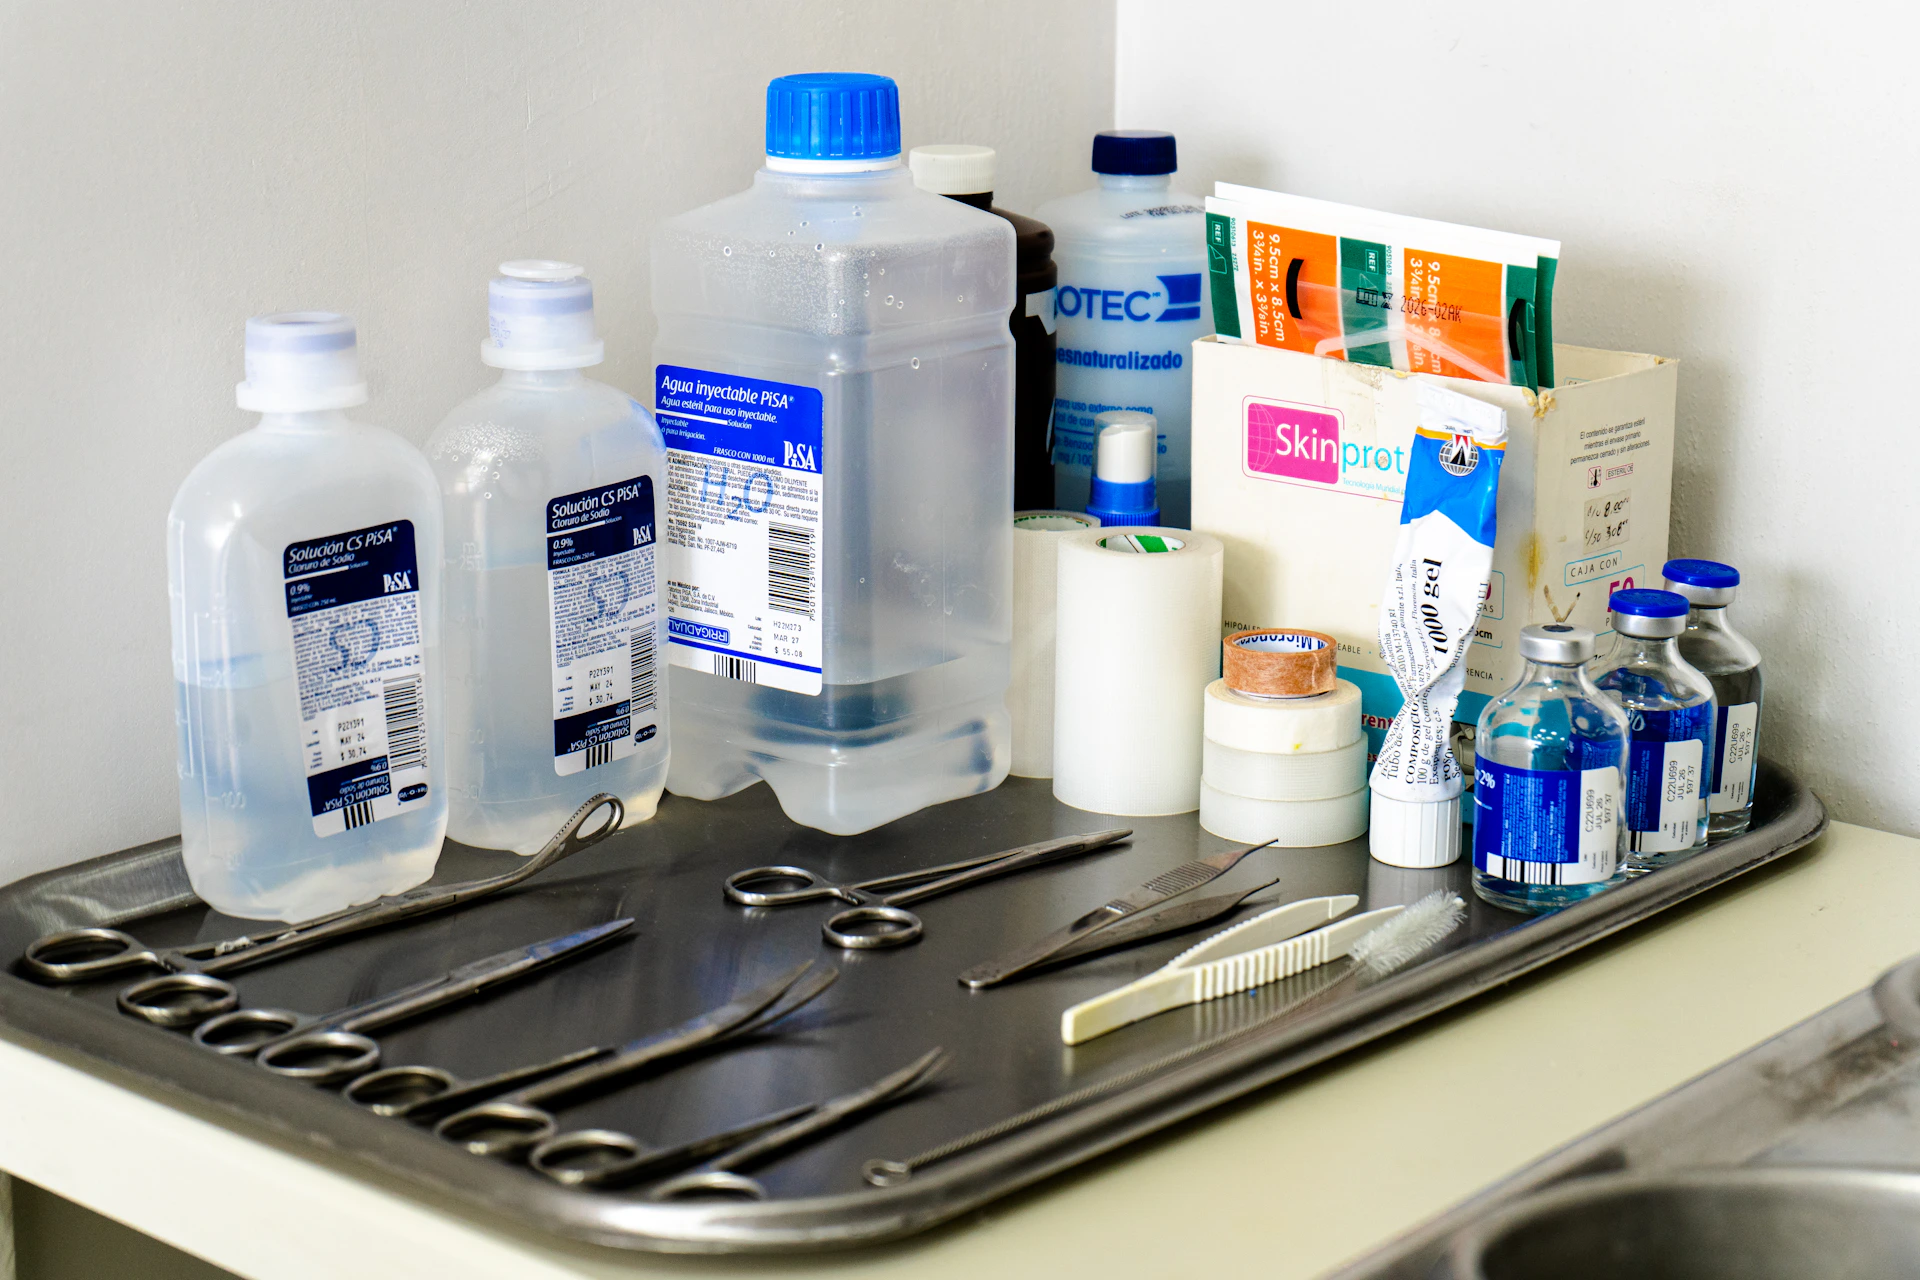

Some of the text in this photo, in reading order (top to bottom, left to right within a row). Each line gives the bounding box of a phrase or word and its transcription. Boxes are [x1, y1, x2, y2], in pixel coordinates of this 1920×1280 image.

[1214, 223, 1222, 243] REF
[1255, 279, 1264, 289] x
[1269, 234, 1285, 342] 9.5cm x 8.5cm
[1057, 285, 1152, 322] OTEC
[661, 376, 693, 395] Agua
[696, 380, 758, 405] inyectable
[661, 396, 778, 424] Agua estéril para uso inyectable.
[1072, 402, 1086, 412] uso
[661, 417, 752, 430] Inyectable Solución
[1586, 427, 1607, 439] contenido
[713, 446, 737, 457] FRASCO
[737, 450, 751, 460] CON
[752, 454, 766, 463] 1000
[552, 496, 599, 519] Solución
[601, 490, 615, 506] CS
[552, 508, 610, 529] Cloruro de Sodio
[288, 541, 344, 563] Solución
[346, 535, 363, 551] CS
[553, 537, 574, 550] 0.9%
[288, 552, 355, 574] Cloruro de Sodio
[1570, 557, 1618, 577] CAJA CON
[290, 583, 311, 596] 0.9%
[1420, 558, 1449, 655] 1000 gel
[773, 620, 802, 631] H22M273
[773, 633, 788, 642] MAR
[783, 648, 803, 658] 55.08
[1337, 643, 1361, 655] EABLE
[1466, 667, 1493, 681] RENCIA
[589, 679, 613, 692] MAY 24
[1361, 713, 1395, 730] rent
[588, 735, 597, 746] CS
[599, 725, 629, 742] Solución
[1405, 694, 1421, 784] COMPOSICIO
[1739, 731, 1746, 742] 26
[1729, 723, 1740, 764] C22U699
[1417, 725, 1434, 784] 100 g de gel
[1387, 750, 1401, 779] Tubo
[1480, 770, 1496, 789] 2%
[1667, 760, 1678, 802] C22U699
[1677, 769, 1686, 800] JUL 26
[1585, 789, 1595, 832] C22U699
[1595, 814, 1603, 830] JUL
